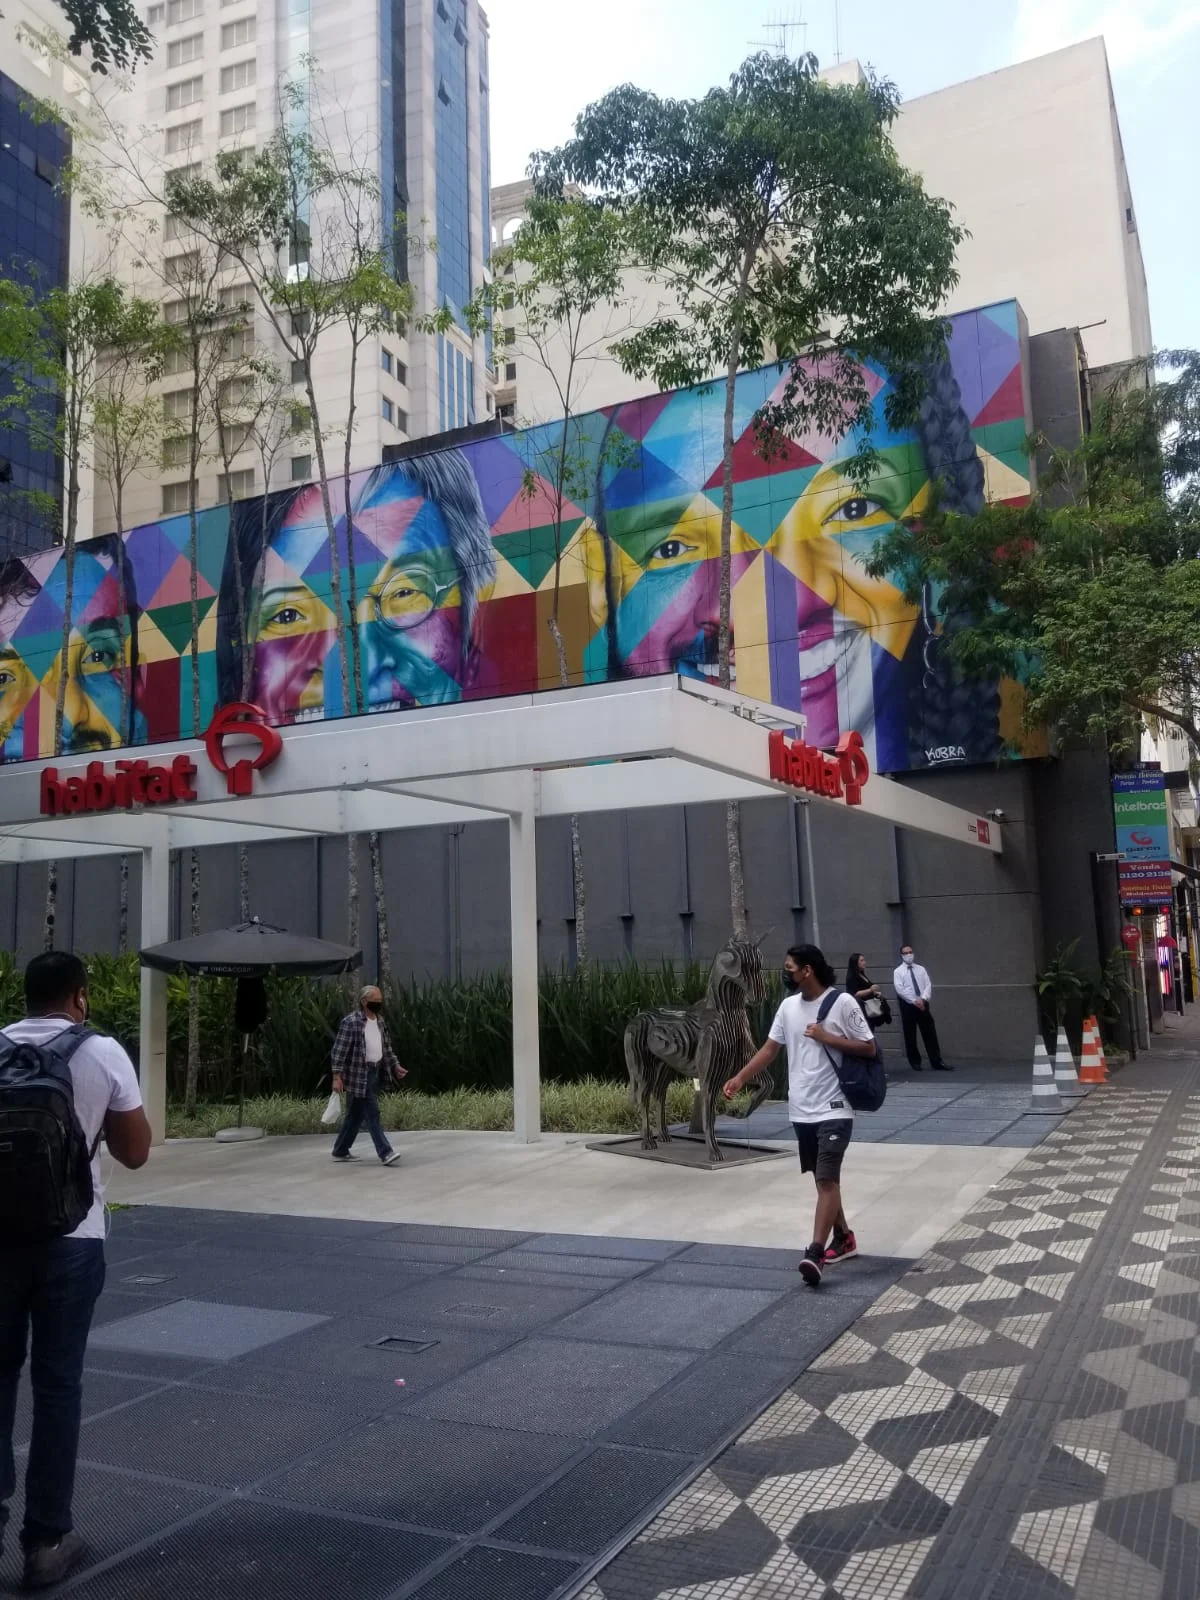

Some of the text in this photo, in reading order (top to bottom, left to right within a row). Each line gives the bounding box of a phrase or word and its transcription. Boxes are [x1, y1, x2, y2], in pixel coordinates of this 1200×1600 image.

[925, 746, 966, 761] KOBRA
[40, 755, 197, 815] habitat
[1114, 801, 1168, 813] intelbras
